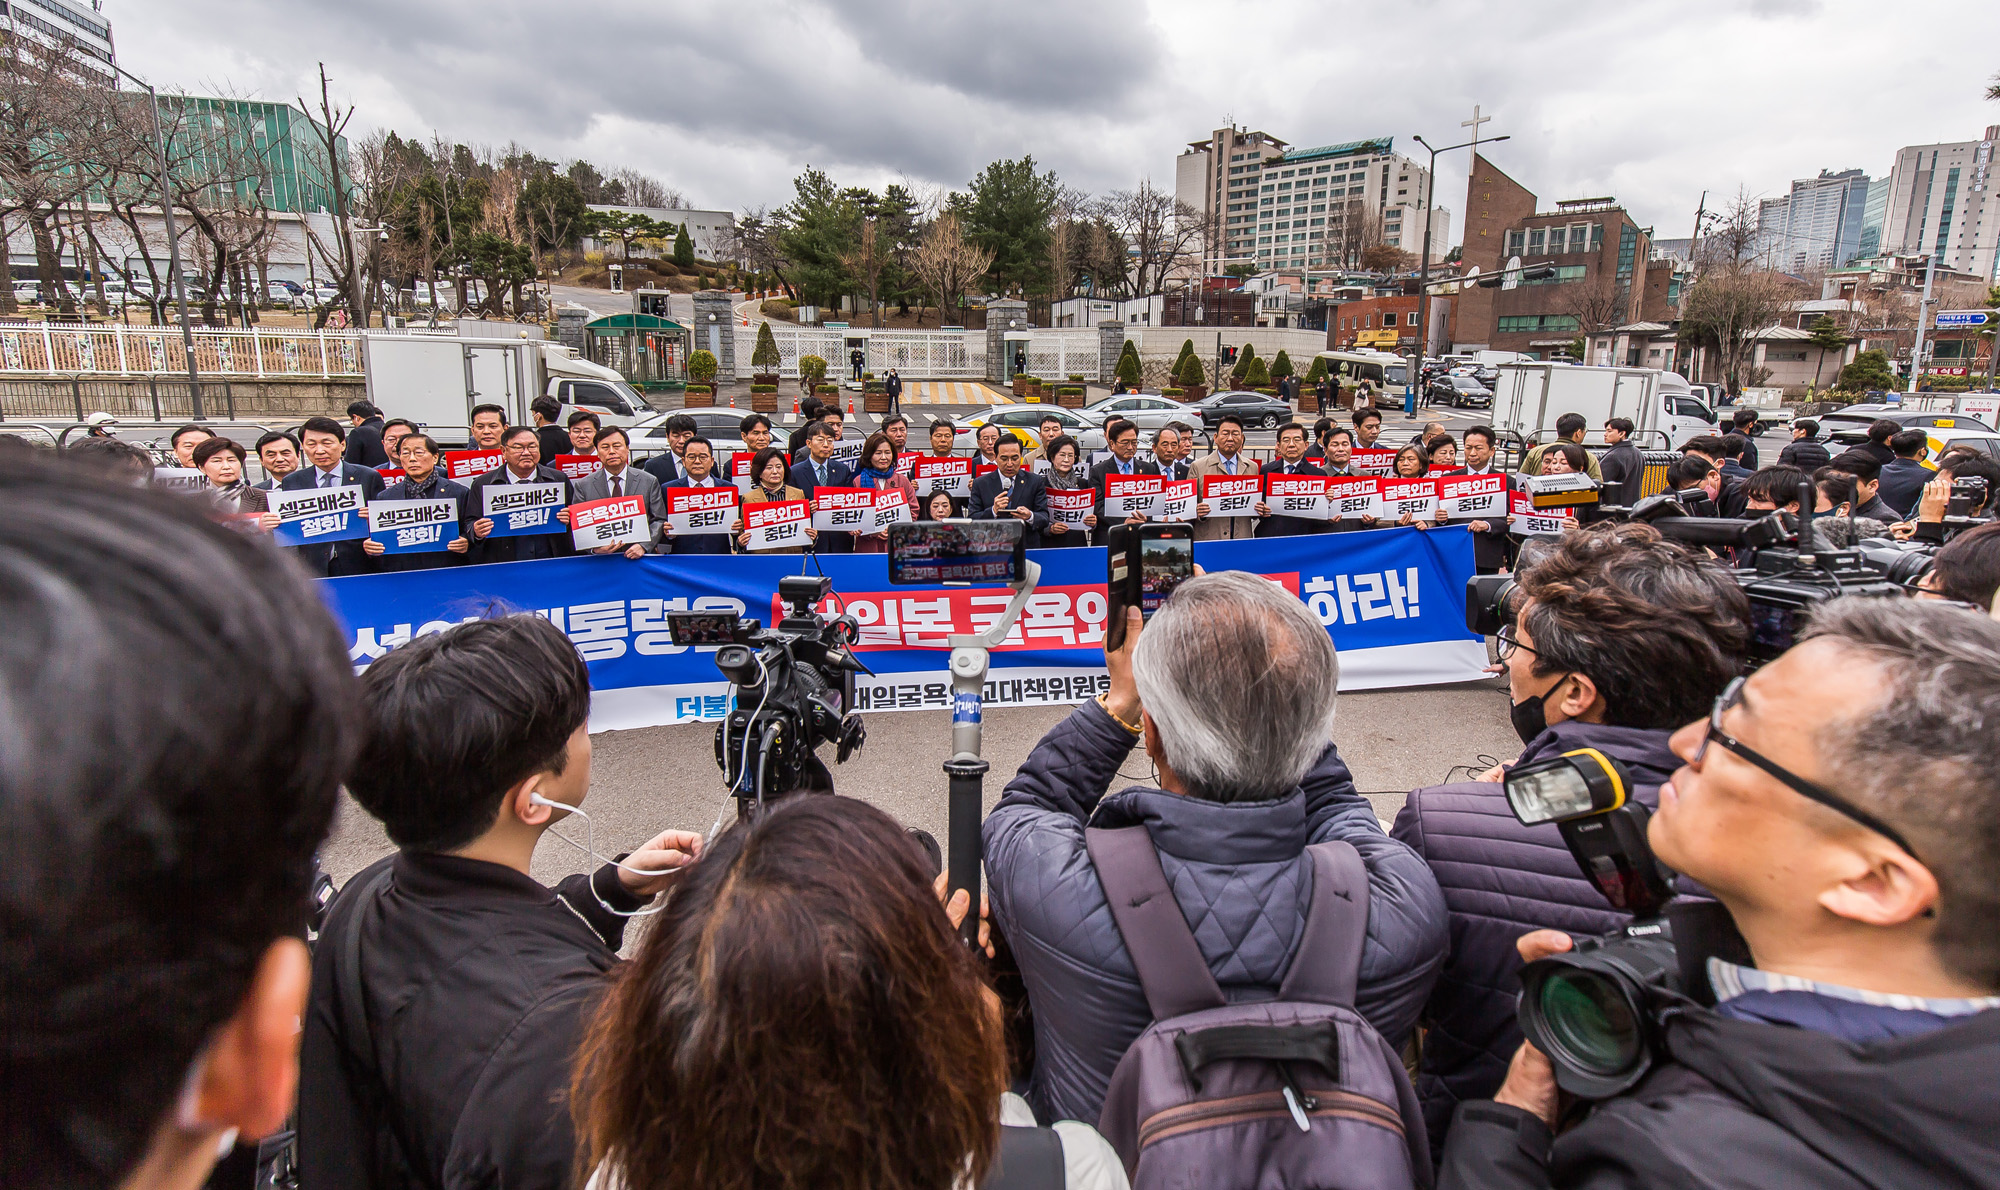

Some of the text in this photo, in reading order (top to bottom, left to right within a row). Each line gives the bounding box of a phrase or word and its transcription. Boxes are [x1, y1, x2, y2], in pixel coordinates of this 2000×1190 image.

[832, 443, 863, 458] 프배상
[453, 454, 504, 477] 굴욕외
[919, 460, 967, 478] 굴욕외교
[931, 477, 961, 491] 중단!
[1110, 478, 1162, 497] 굴욕외교
[1207, 478, 1259, 497] 굴욕외교
[1271, 480, 1326, 495] 굴욕외교
[1330, 479, 1378, 499] 굴욕외교
[1384, 481, 1436, 501] 굴욕외교
[1443, 477, 1501, 499] 굴욕외교
[278, 490, 357, 519] 셀프배상
[490, 487, 560, 512] 셀프배상
[673, 490, 734, 513] 굴욕외교
[818, 491, 872, 510] 굴욕외교
[1122, 496, 1155, 512] 중단!
[1219, 495, 1251, 511] 중단!
[1283, 496, 1317, 511] 중단!
[1340, 497, 1371, 513] 중단!
[1397, 499, 1429, 515] 중단!
[1457, 495, 1493, 512] 중단!
[377, 503, 451, 529] 셀프배상
[508, 507, 550, 530] 철회!
[576, 499, 641, 528] 굴욕외교
[688, 510, 726, 528] 중단!
[749, 502, 806, 528] 굴욕외교
[831, 509, 864, 525] 중단!
[1053, 510, 1085, 523] 중단!
[300, 512, 349, 539] 철회!
[595, 518, 634, 540] 중단!
[764, 522, 799, 543] 중단!
[1526, 517, 1559, 532] 중단!
[396, 524, 442, 548] 철회!
[509, 596, 747, 663] 통령은
[781, 598, 955, 646] 일본
[970, 591, 1108, 645] 굴욕외
[1304, 567, 1420, 626] 하라!
[675, 695, 738, 720] 더불
[1577, 822, 1604, 833] Canon
[1627, 924, 1662, 937] Canon
